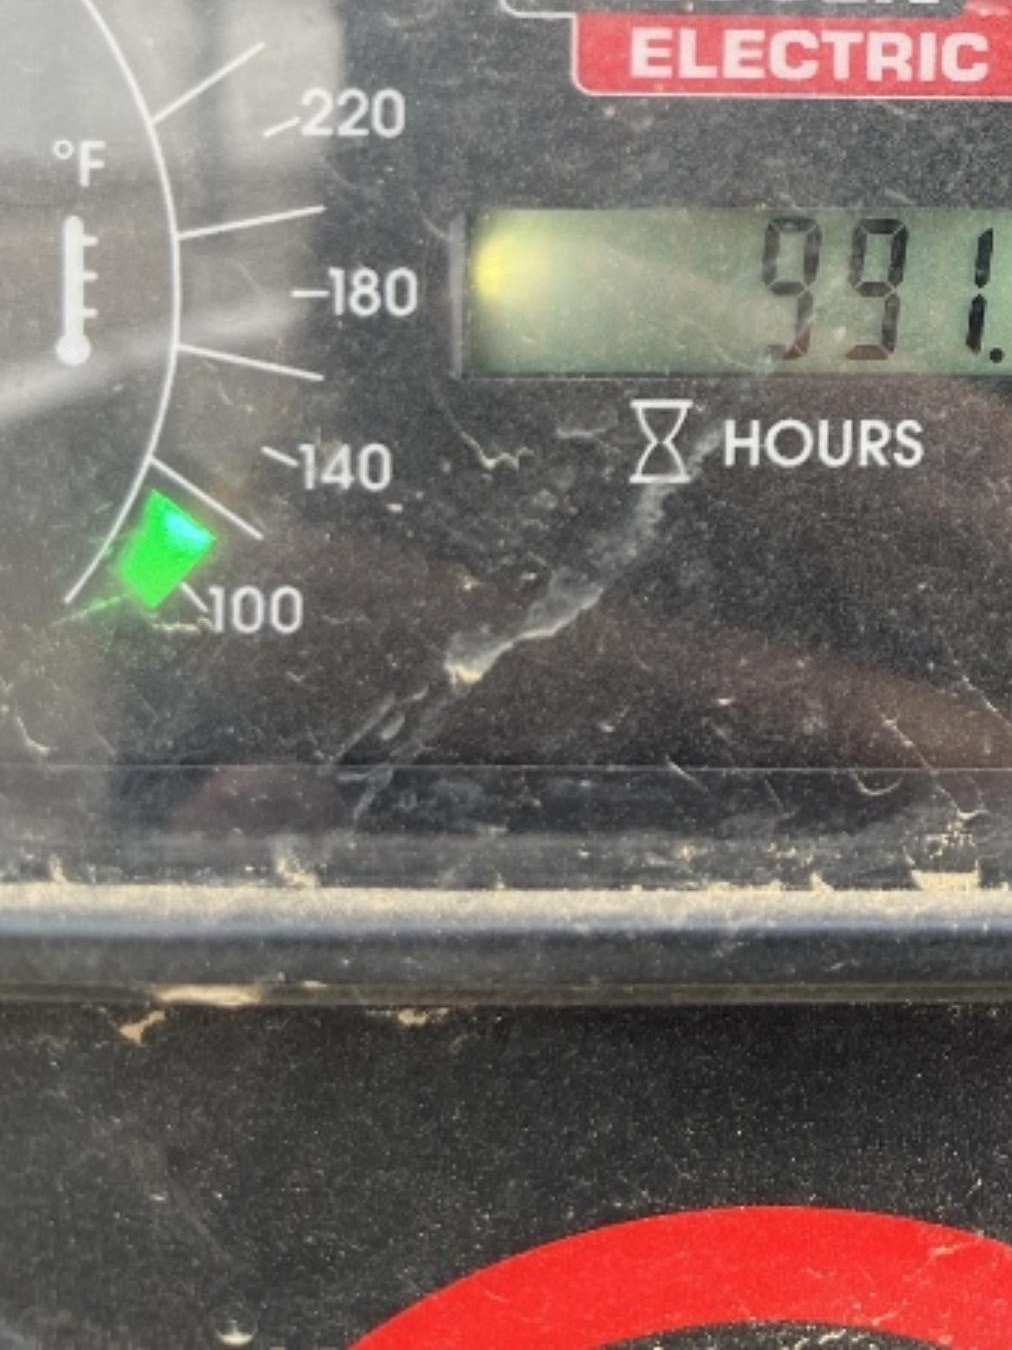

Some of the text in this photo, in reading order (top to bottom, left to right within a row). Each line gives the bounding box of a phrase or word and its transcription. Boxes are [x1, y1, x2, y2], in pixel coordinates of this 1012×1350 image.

[629, 26, 990, 83] ELECTRIC
[300, 89, 406, 139] 220
[329, 267, 418, 317] 180
[298, 445, 393, 492] 140
[723, 420, 925, 468] HOURS
[209, 588, 304, 635] 100
